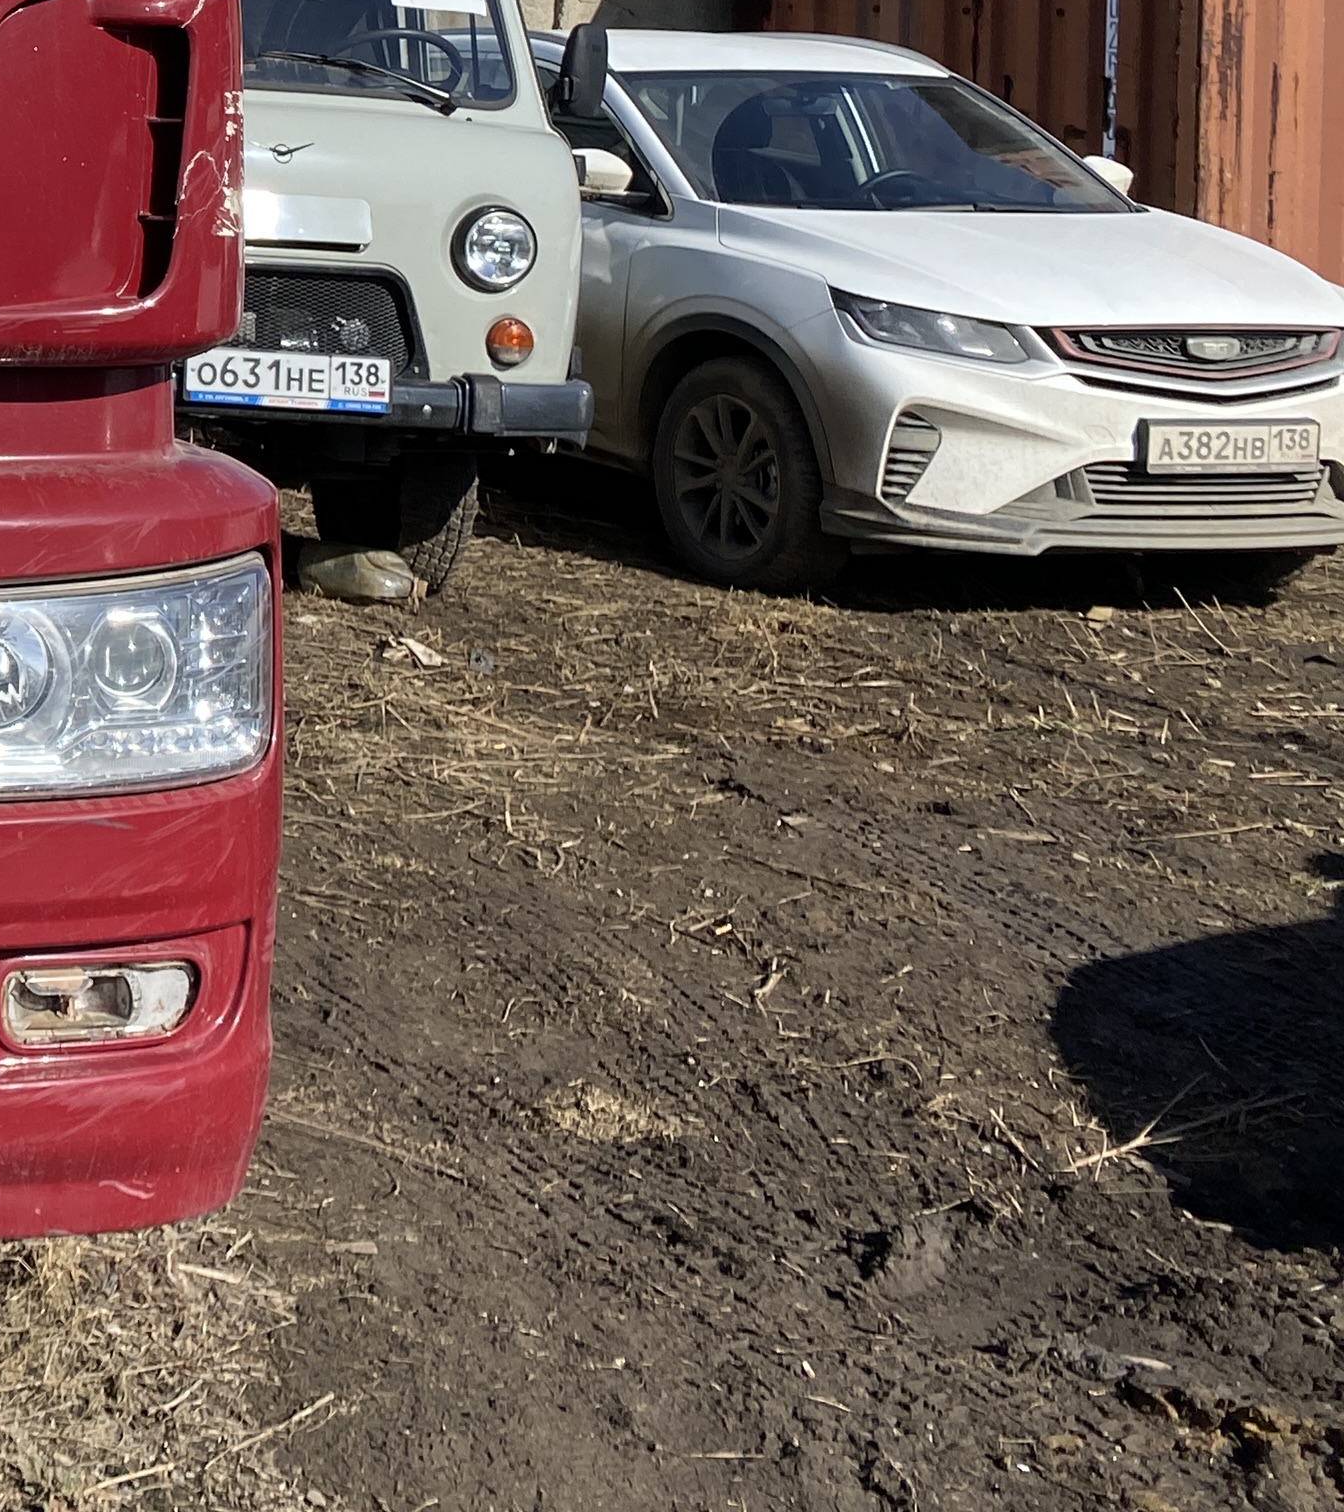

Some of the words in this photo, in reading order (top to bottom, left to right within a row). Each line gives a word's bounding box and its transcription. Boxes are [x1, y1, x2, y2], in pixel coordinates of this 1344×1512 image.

[334, 361, 380, 386] 138
[344, 386, 368, 397] RUS
[1272, 428, 1311, 452] 138
